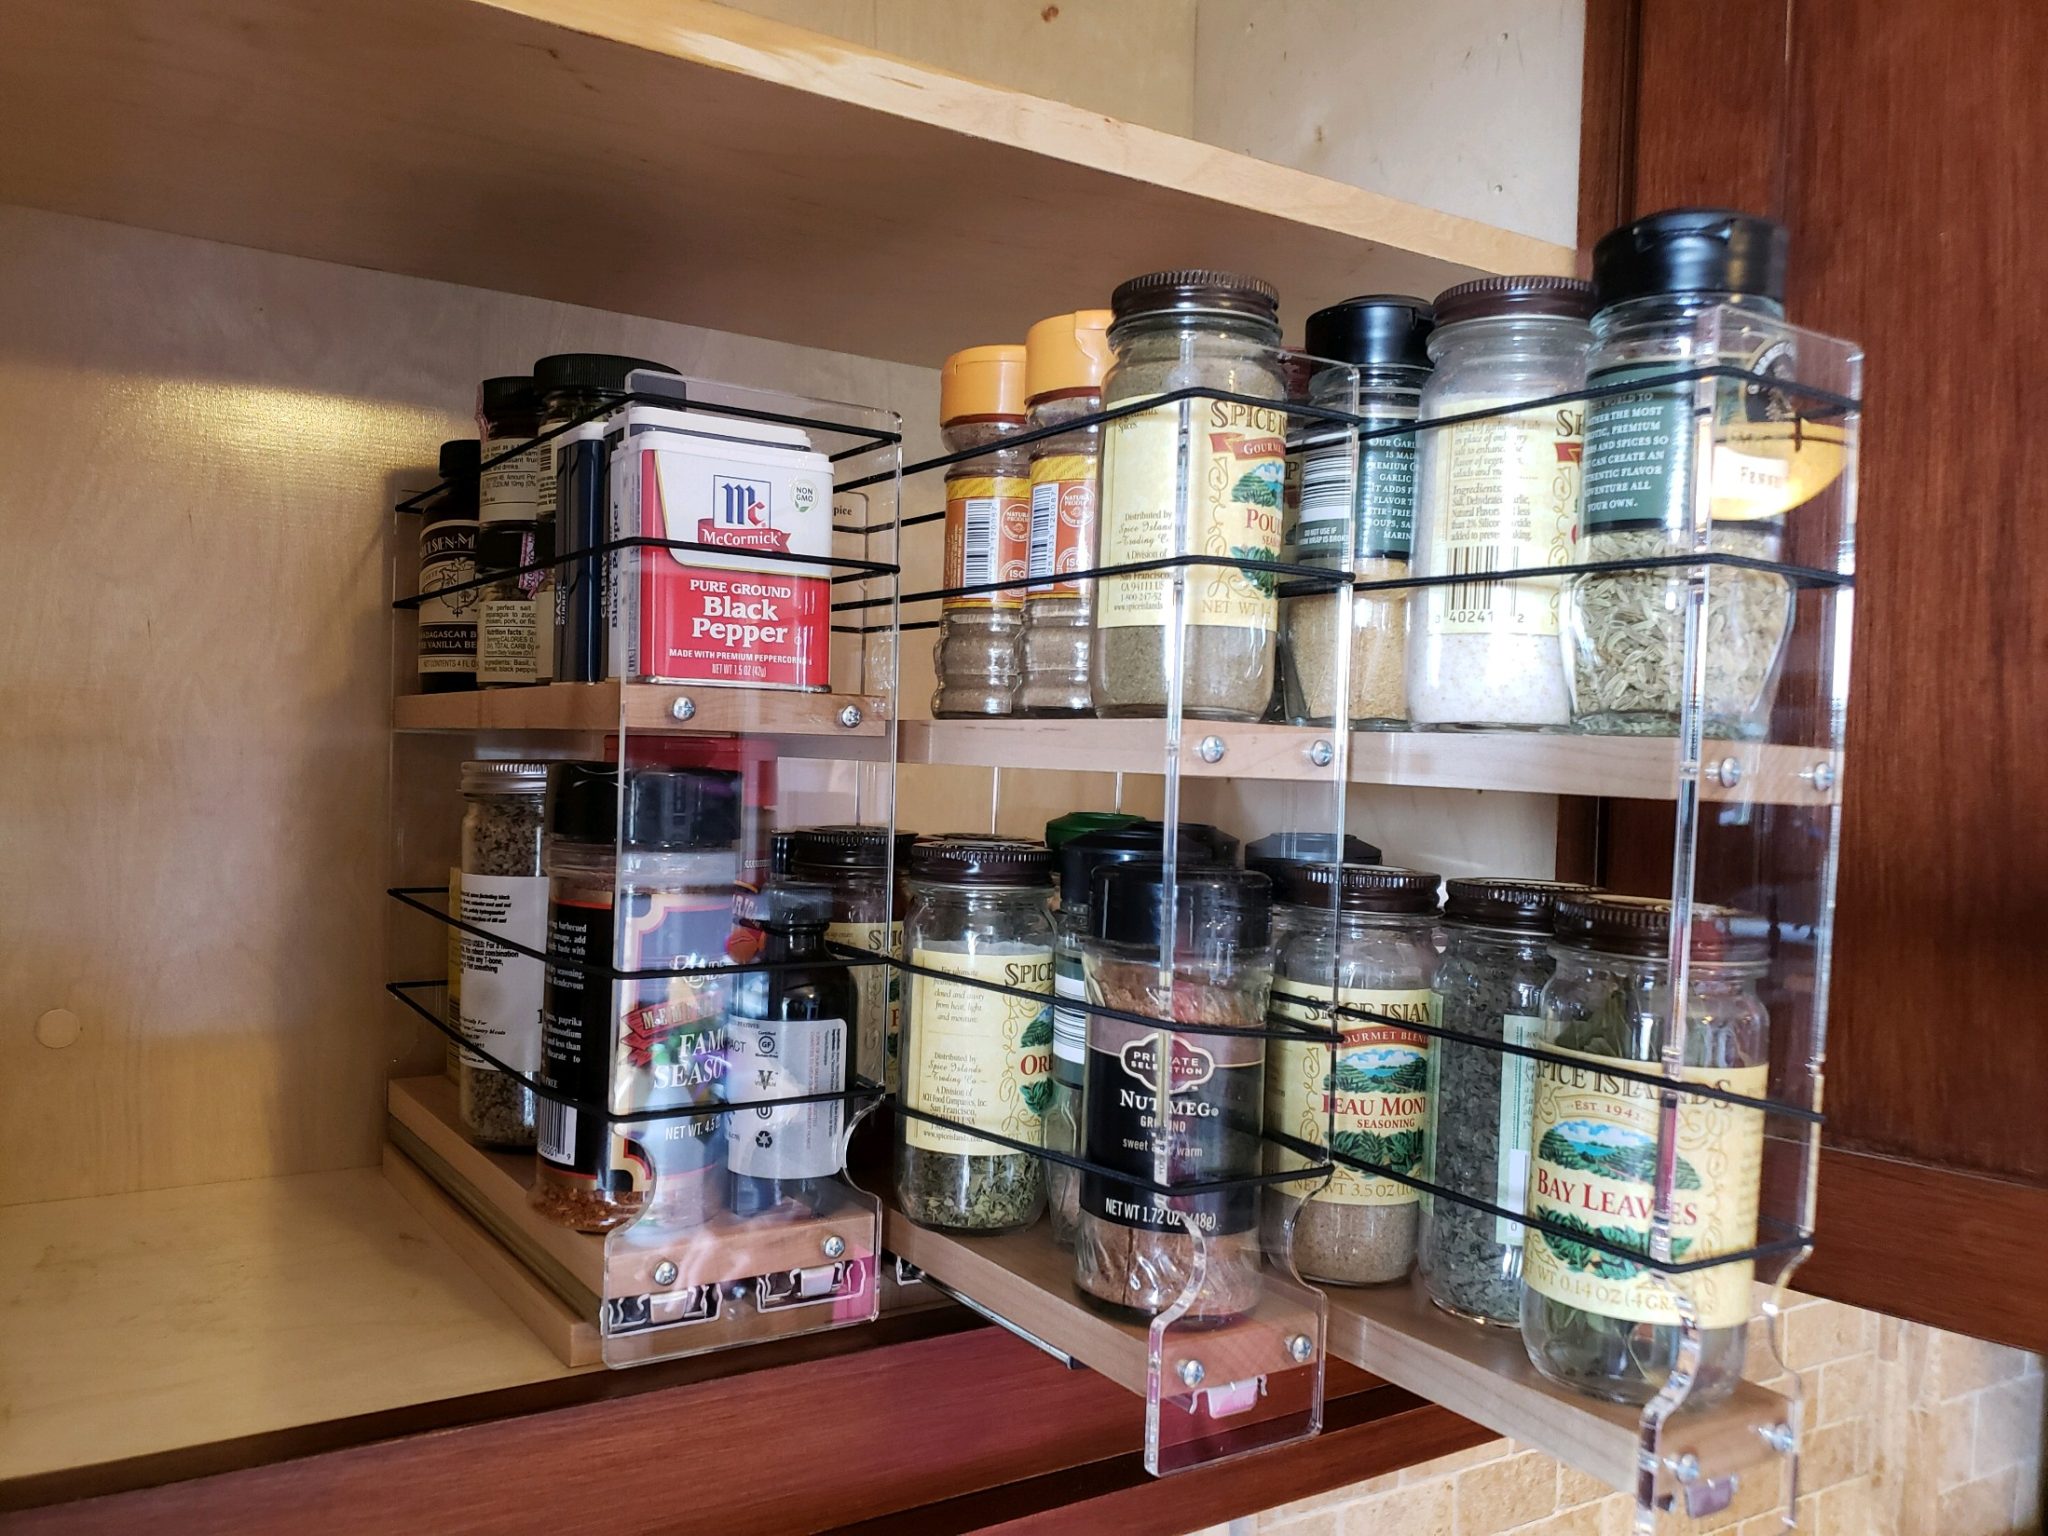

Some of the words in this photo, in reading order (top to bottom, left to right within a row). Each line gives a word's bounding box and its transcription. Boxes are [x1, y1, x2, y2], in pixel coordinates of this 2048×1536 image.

[1637, 392, 1654, 401] TO
[1610, 409, 1631, 420] THE
[1631, 406, 1665, 418] MOST
[1611, 421, 1661, 434] PREMIUM
[1616, 437, 1651, 448] SPICES
[1652, 435, 1669, 445] SO
[1607, 451, 1647, 464] CREATE
[1647, 450, 1665, 460] AN
[1620, 465, 1663, 477] FLAVOR
[1379, 474, 1412, 483] GARLIC
[796, 486, 813, 496] NON
[1383, 485, 1406, 493] ADDS
[1629, 480, 1652, 491] ALL
[796, 494, 813, 503] GMO
[1373, 497, 1407, 505] FLAVOR
[1587, 501, 1608, 512] YOUR
[702, 528, 781, 546] McCormick
[690, 579, 728, 593] PURE
[731, 583, 791, 598] GROUND
[703, 595, 779, 621] Black
[1517, 613, 1524, 624] 2
[692, 617, 788, 648] Pepper
[428, 640, 462, 649] VANILLA
[669, 649, 693, 658] MADE
[694, 650, 715, 659] WITH
[716, 651, 753, 662] PREMIUM
[712, 663, 723, 674] NET
[724, 664, 733, 675] WT
[733, 665, 743, 675] 1.5
[573, 935, 587, 945] add
[571, 945, 586, 956] with
[566, 1038, 581, 1051] than
[761, 1041, 772, 1049] GF
[573, 1054, 581, 1064] to
[1133, 1051, 1200, 1067] PRIATE
[1131, 1060, 1203, 1075] SELETION
[930, 1103, 941, 1112] San
[1140, 1115, 1187, 1133] GRND
[1357, 1118, 1415, 1129] SEASONING
[665, 1124, 686, 1141] NET
[1122, 1137, 1149, 1152] sweet
[1177, 1143, 1203, 1157] warm
[1351, 1183, 1373, 1197] 3.5
[1375, 1184, 1395, 1198] OZ
[1537, 1167, 1575, 1205] BAY
[1583, 1182, 1698, 1225] LEAVES
[1106, 1198, 1123, 1217] NET
[1124, 1202, 1140, 1221] WT
[1142, 1206, 1165, 1225] 1.72
[1166, 1209, 1181, 1226] OZ
[1538, 1270, 1555, 1286] WT
[1560, 1276, 1592, 1296] 0.14
[1596, 1284, 1622, 1303] OZ
